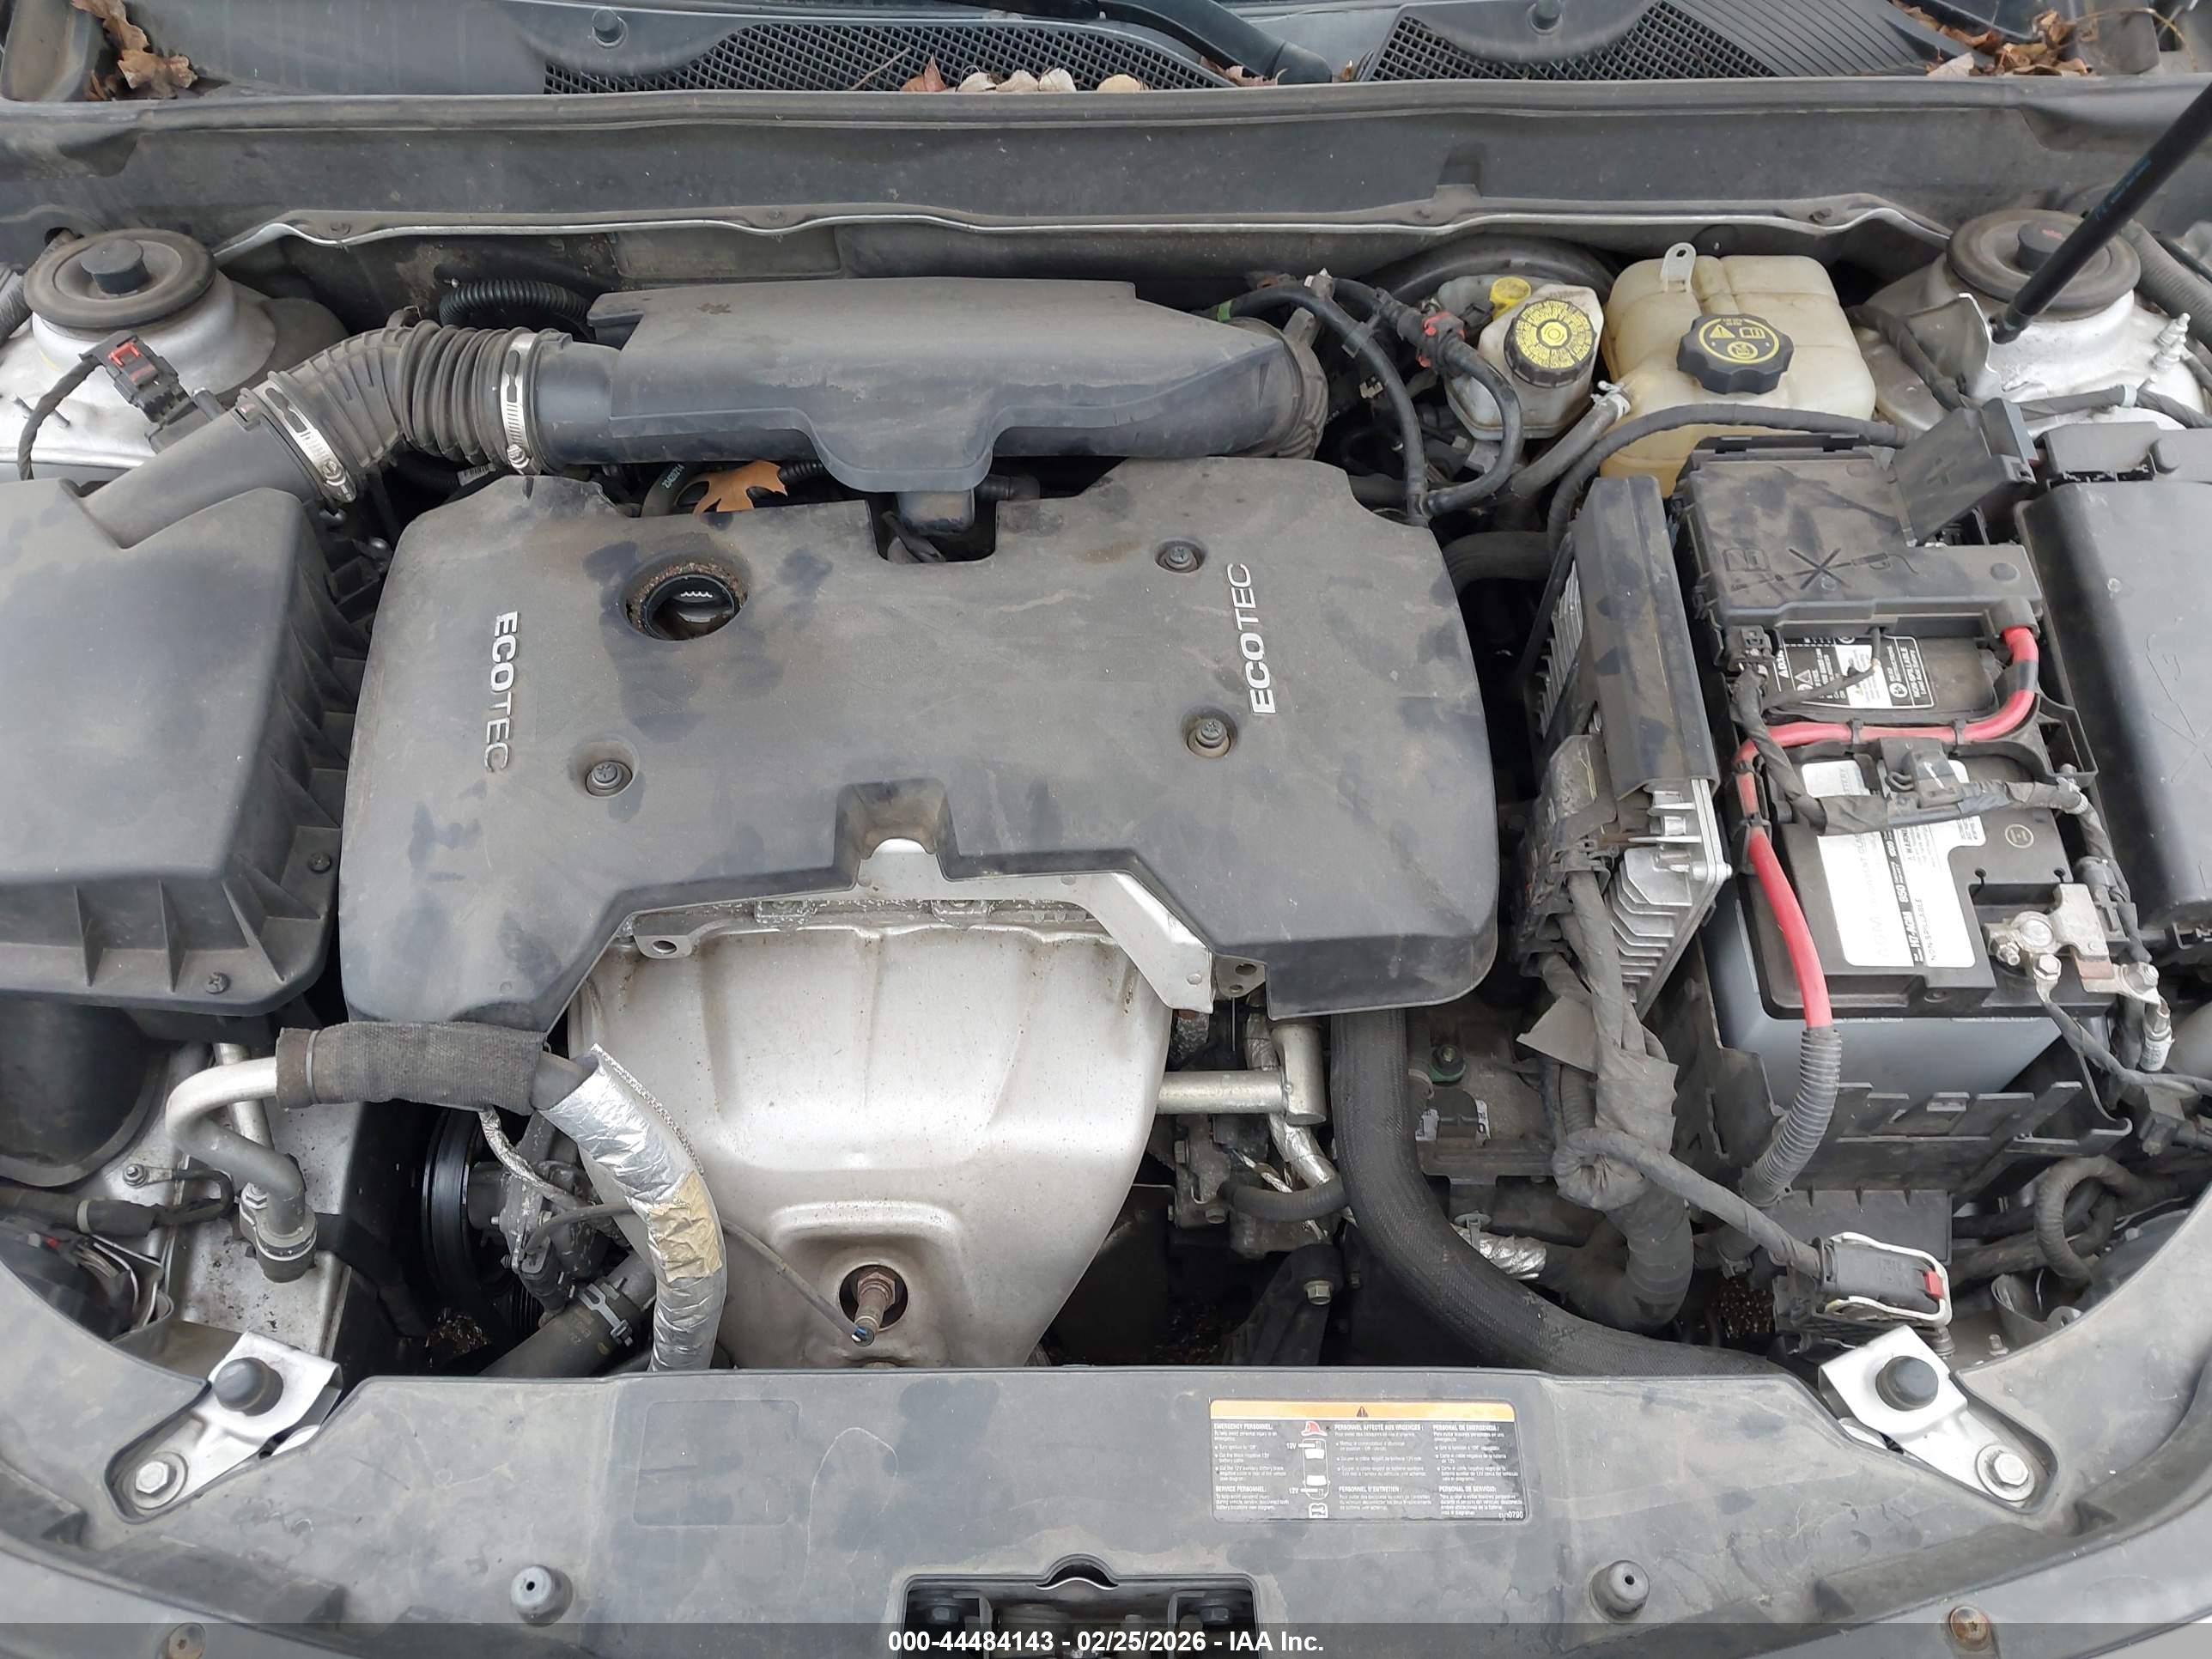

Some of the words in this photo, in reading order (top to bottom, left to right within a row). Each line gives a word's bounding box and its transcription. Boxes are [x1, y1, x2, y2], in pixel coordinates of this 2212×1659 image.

[1227, 563, 1277, 714] ECOTEC
[484, 611, 519, 773] ECOTEC
[1895, 884, 1910, 903] 850
[1902, 910, 1921, 948] H7-AGM
[1915, 899, 1936, 961] NON-SPILLABLE
